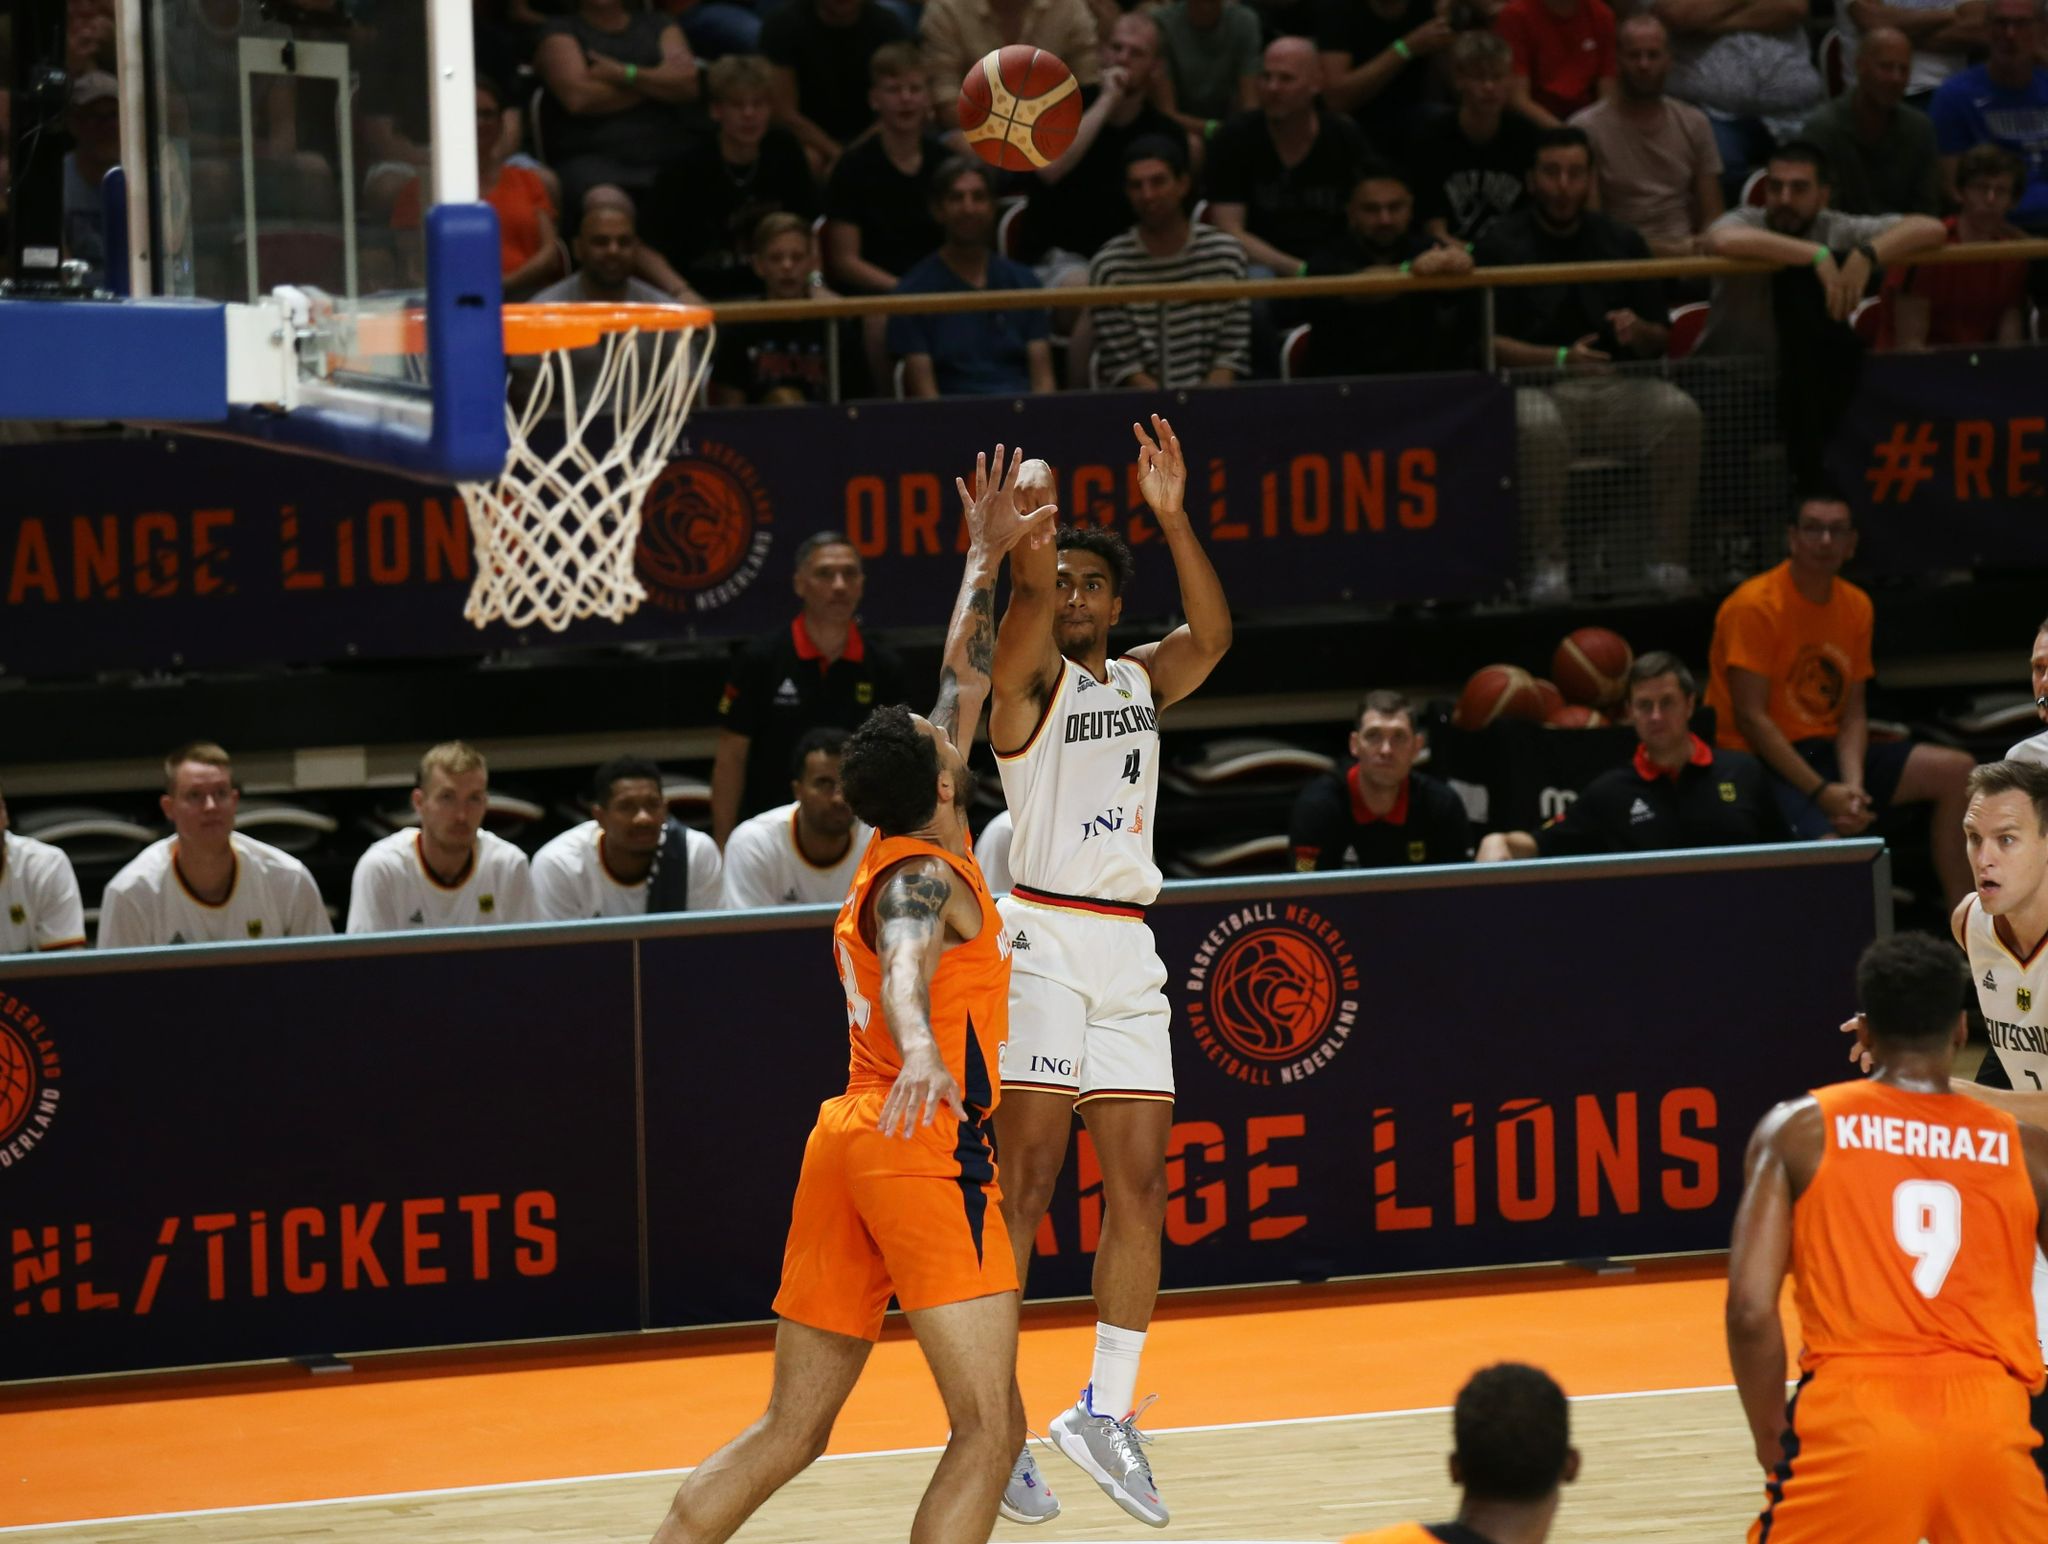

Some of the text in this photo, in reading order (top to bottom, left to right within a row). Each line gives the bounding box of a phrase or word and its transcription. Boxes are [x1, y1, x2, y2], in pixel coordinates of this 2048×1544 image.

[1121, 748, 1141, 785] 4
[1081, 806, 1124, 842] ING
[1186, 902, 1360, 991] BASKETBALL NEDERLAND
[1030, 1055, 1072, 1076] ING
[1187, 1000, 1359, 1086] BASKETBALL NEDERLAND
[1373, 1086, 1720, 1232] LIONS
[1835, 1113, 2010, 1167] KHERRAZI
[1892, 1178, 1963, 1299] 9
